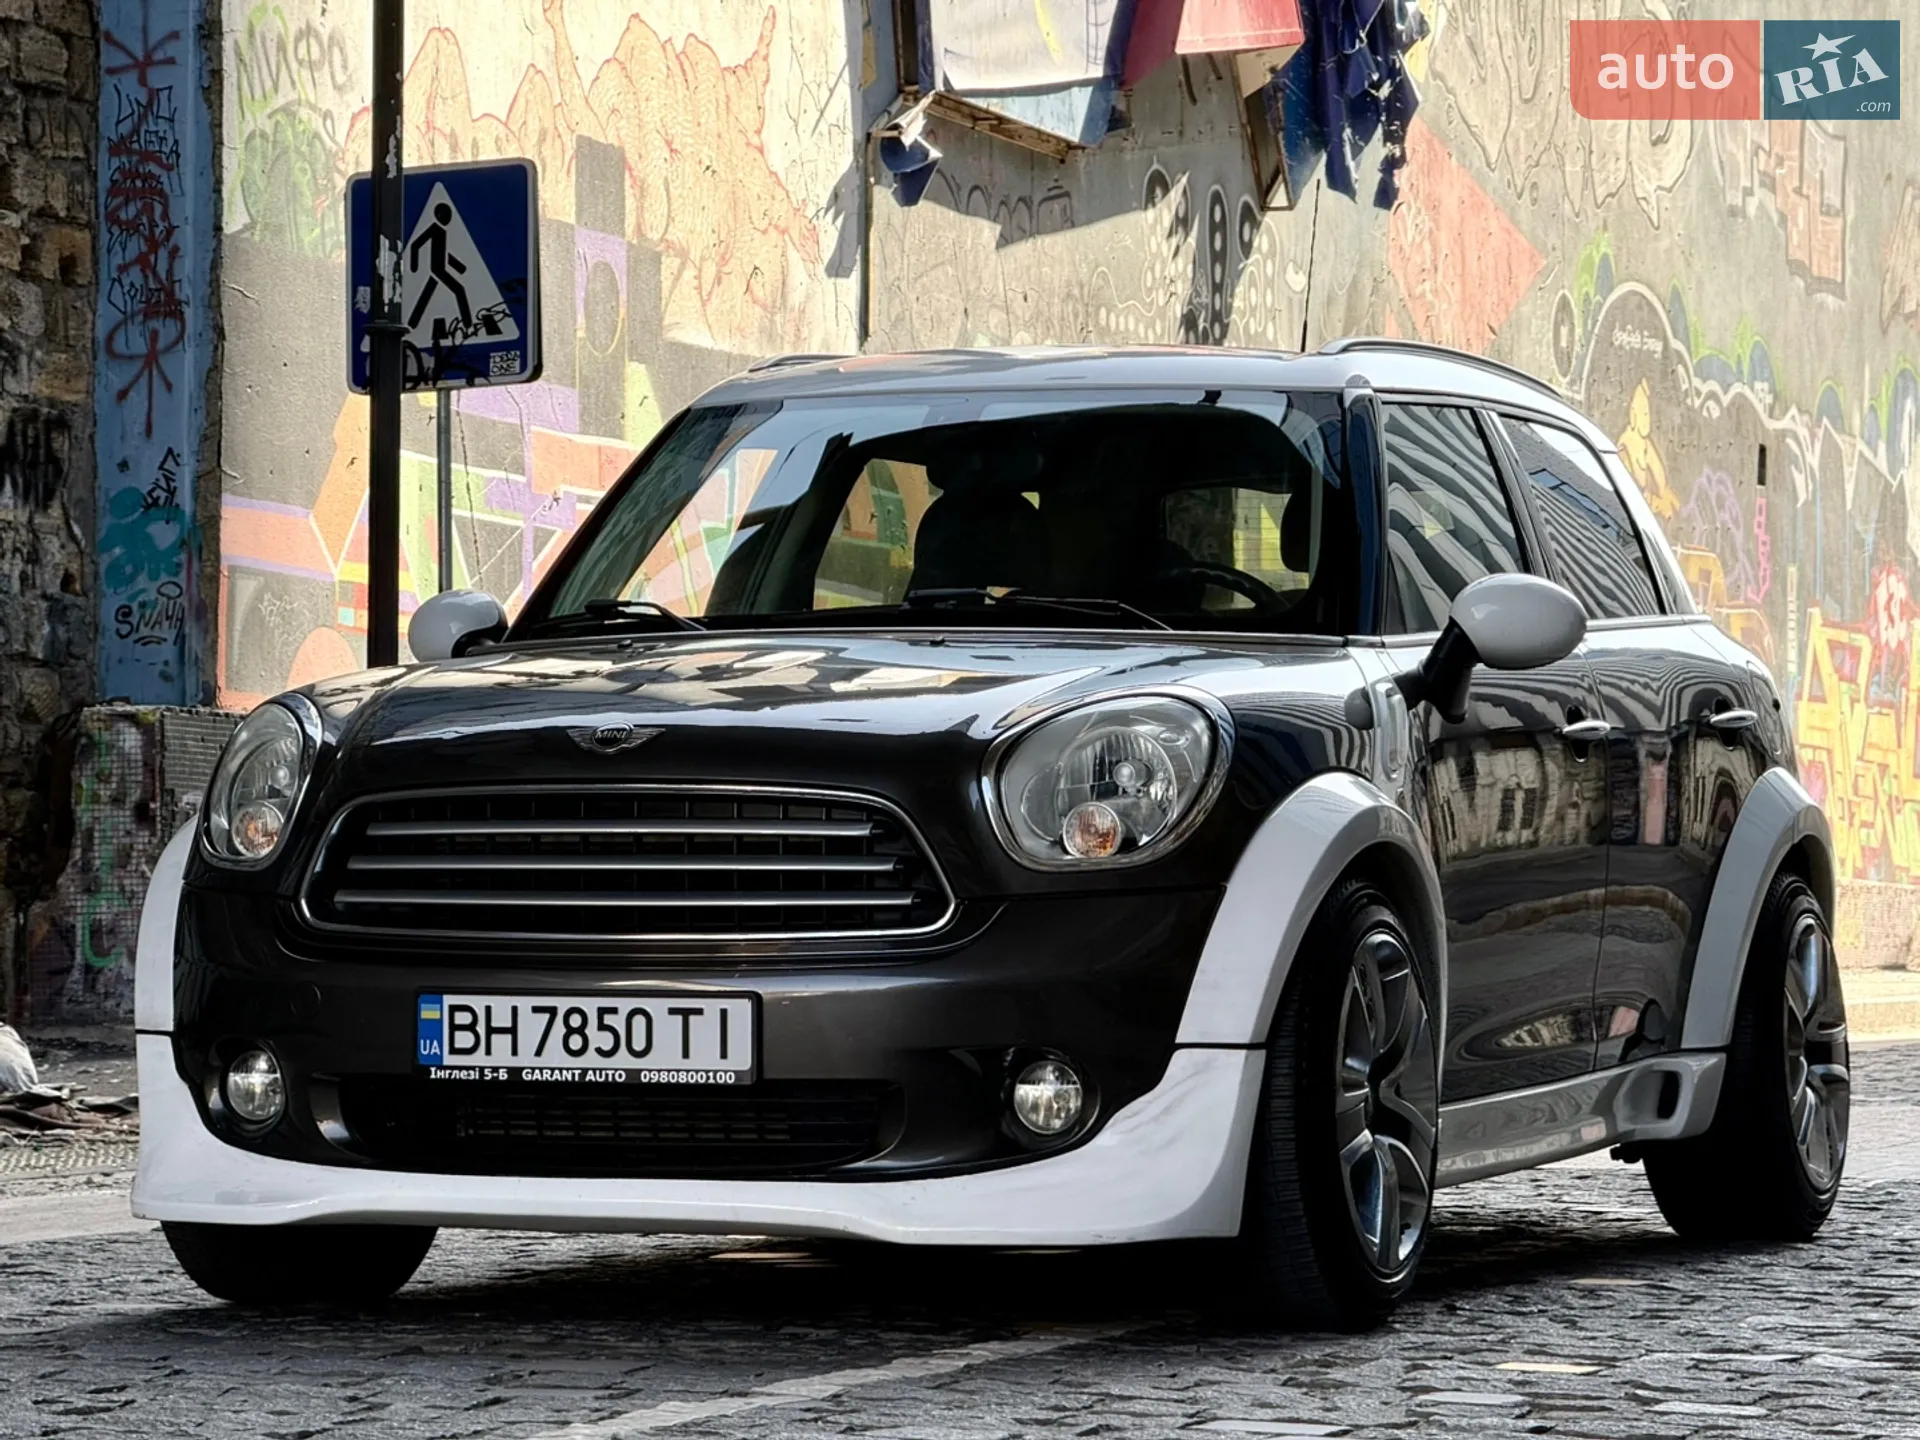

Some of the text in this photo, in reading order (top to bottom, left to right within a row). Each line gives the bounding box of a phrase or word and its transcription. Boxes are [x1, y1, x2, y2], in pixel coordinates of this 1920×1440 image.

[594, 730, 627, 739] MINI
[448, 1004, 728, 1060] BH 7850 TI
[420, 1039, 440, 1055] UA
[429, 1067, 508, 1081] Інглезі 5-Б
[522, 1069, 626, 1083] GARANT AUTO
[640, 1071, 736, 1084] 0980800100
